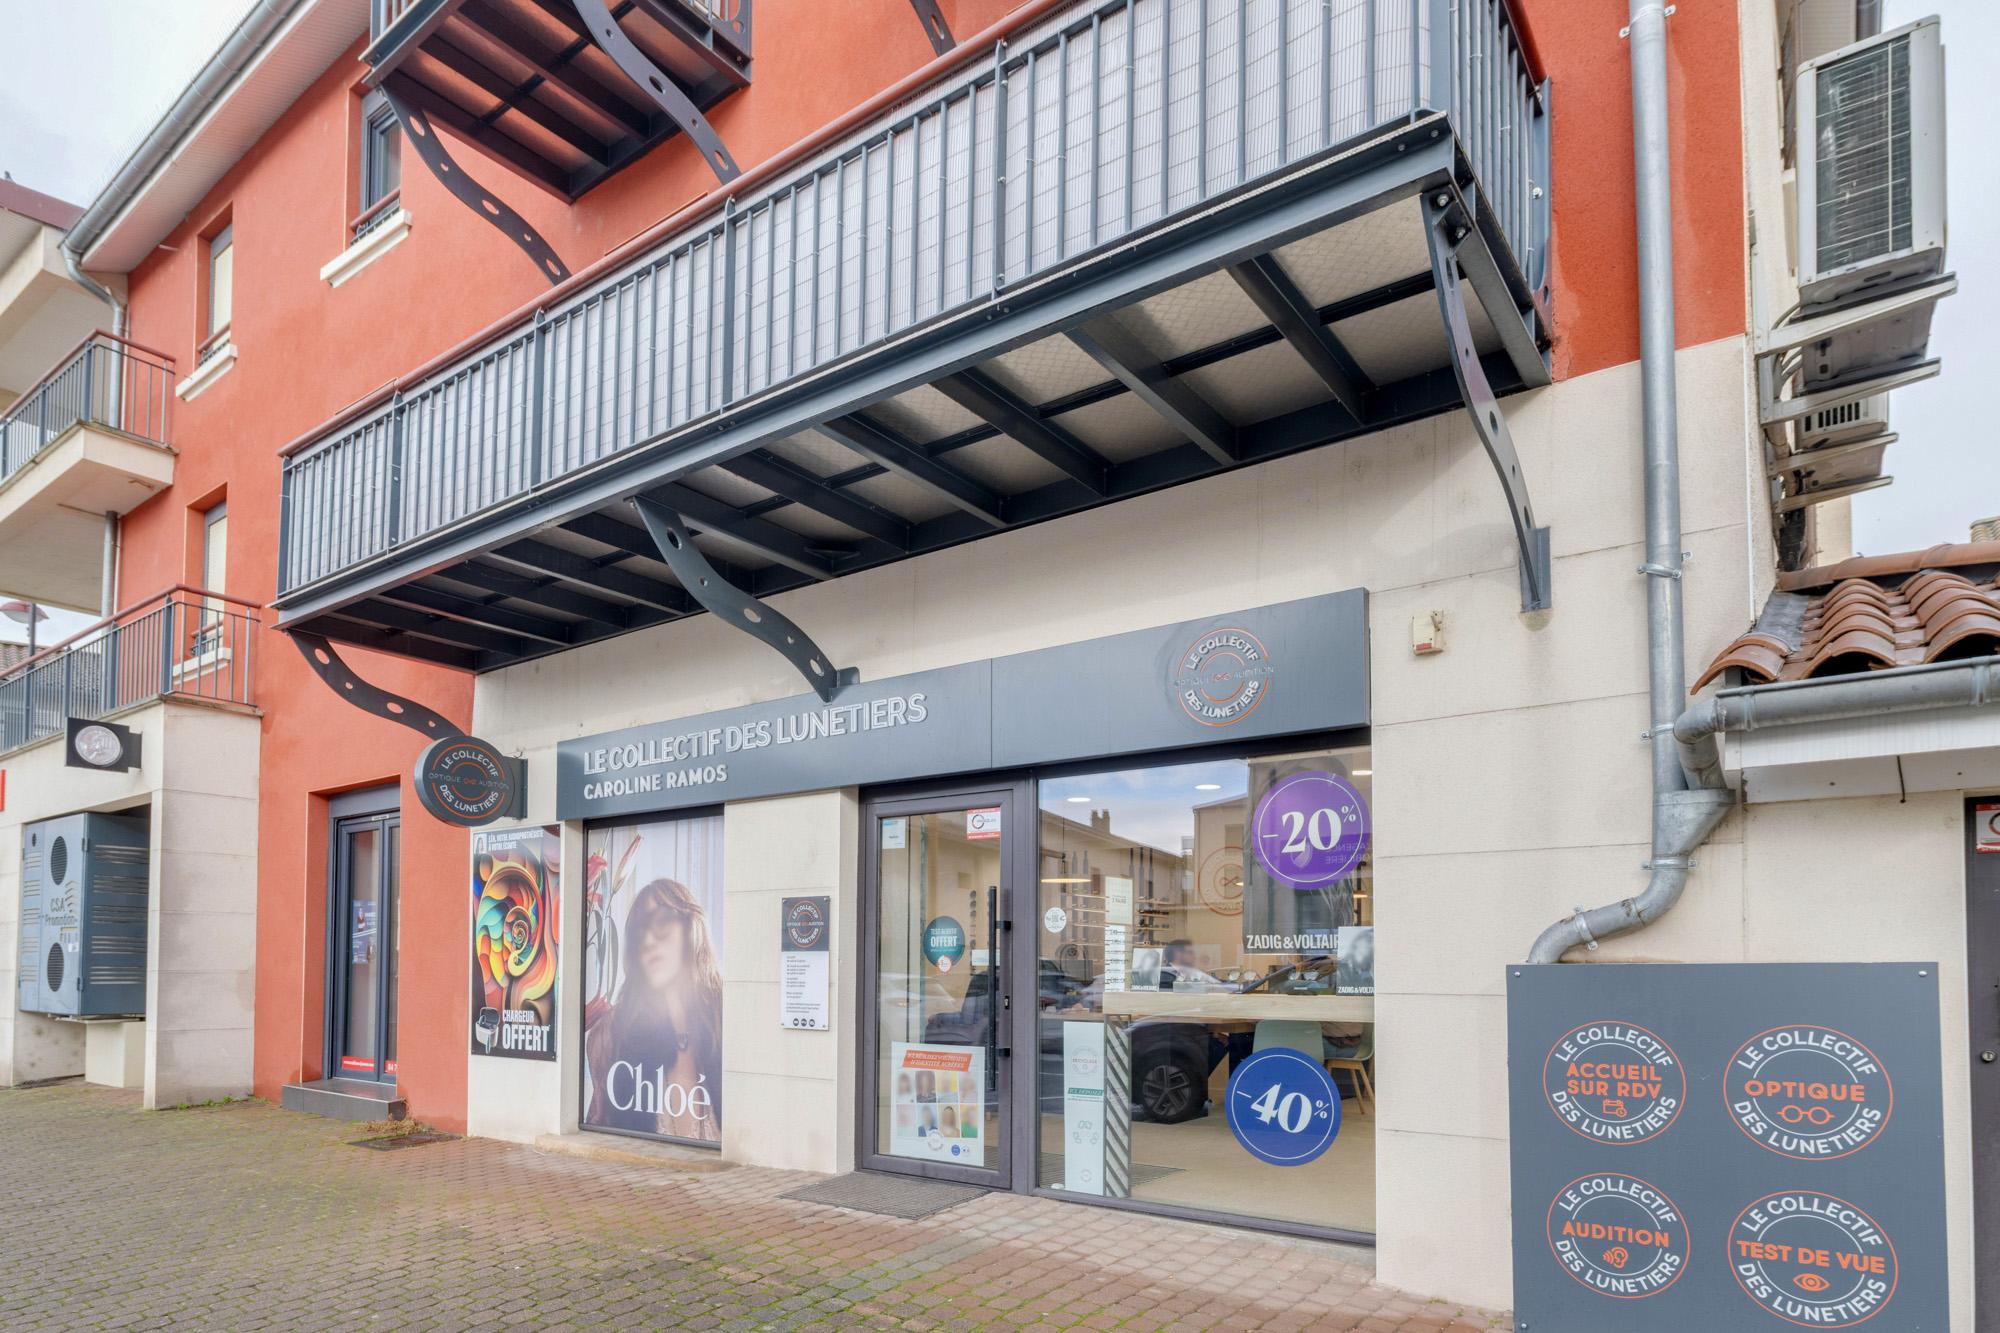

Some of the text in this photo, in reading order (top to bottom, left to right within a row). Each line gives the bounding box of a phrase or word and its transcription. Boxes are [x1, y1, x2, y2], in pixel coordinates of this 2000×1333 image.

[1186, 635, 1260, 670] LE COLLECTIF
[1185, 680, 1259, 718] DES LUNETIERS
[584, 693, 928, 776] LE COLLECTIF DES LUNETIERS
[441, 750, 499, 777] LE COLLECTIF
[583, 764, 728, 801] CAROLINE RAMOS
[440, 784, 499, 813] DES LUNETIERS
[1262, 804, 1357, 854] -20%
[930, 936, 957, 947] OFFERT
[502, 1010, 534, 1022] CHARGEUR
[1555, 1026, 1673, 1067] LE COLLECTIF
[1737, 1030, 1878, 1075] LE COLLECTIF
[606, 1060, 712, 1120] Chloé
[1566, 1063, 1662, 1081] ACCUEIL
[1567, 1079, 1662, 1100] SUR RDV
[1744, 1080, 1865, 1102] OPTIQUE
[1236, 1082, 1330, 1134] -40%
[1552, 1091, 1676, 1139] DES LUNETIERS
[1734, 1101, 1881, 1154] DES LUNETIERS
[1559, 1178, 1677, 1223] LE COLLECTIF
[1562, 1220, 1670, 1248] AUDITION
[1741, 1196, 1883, 1246] LE COLLECTIF
[1556, 1240, 1680, 1293] DES LUNETIERS
[1736, 1239, 1886, 1274] TEST DE VUE
[1738, 1263, 1887, 1323] DES LUNETIERS
